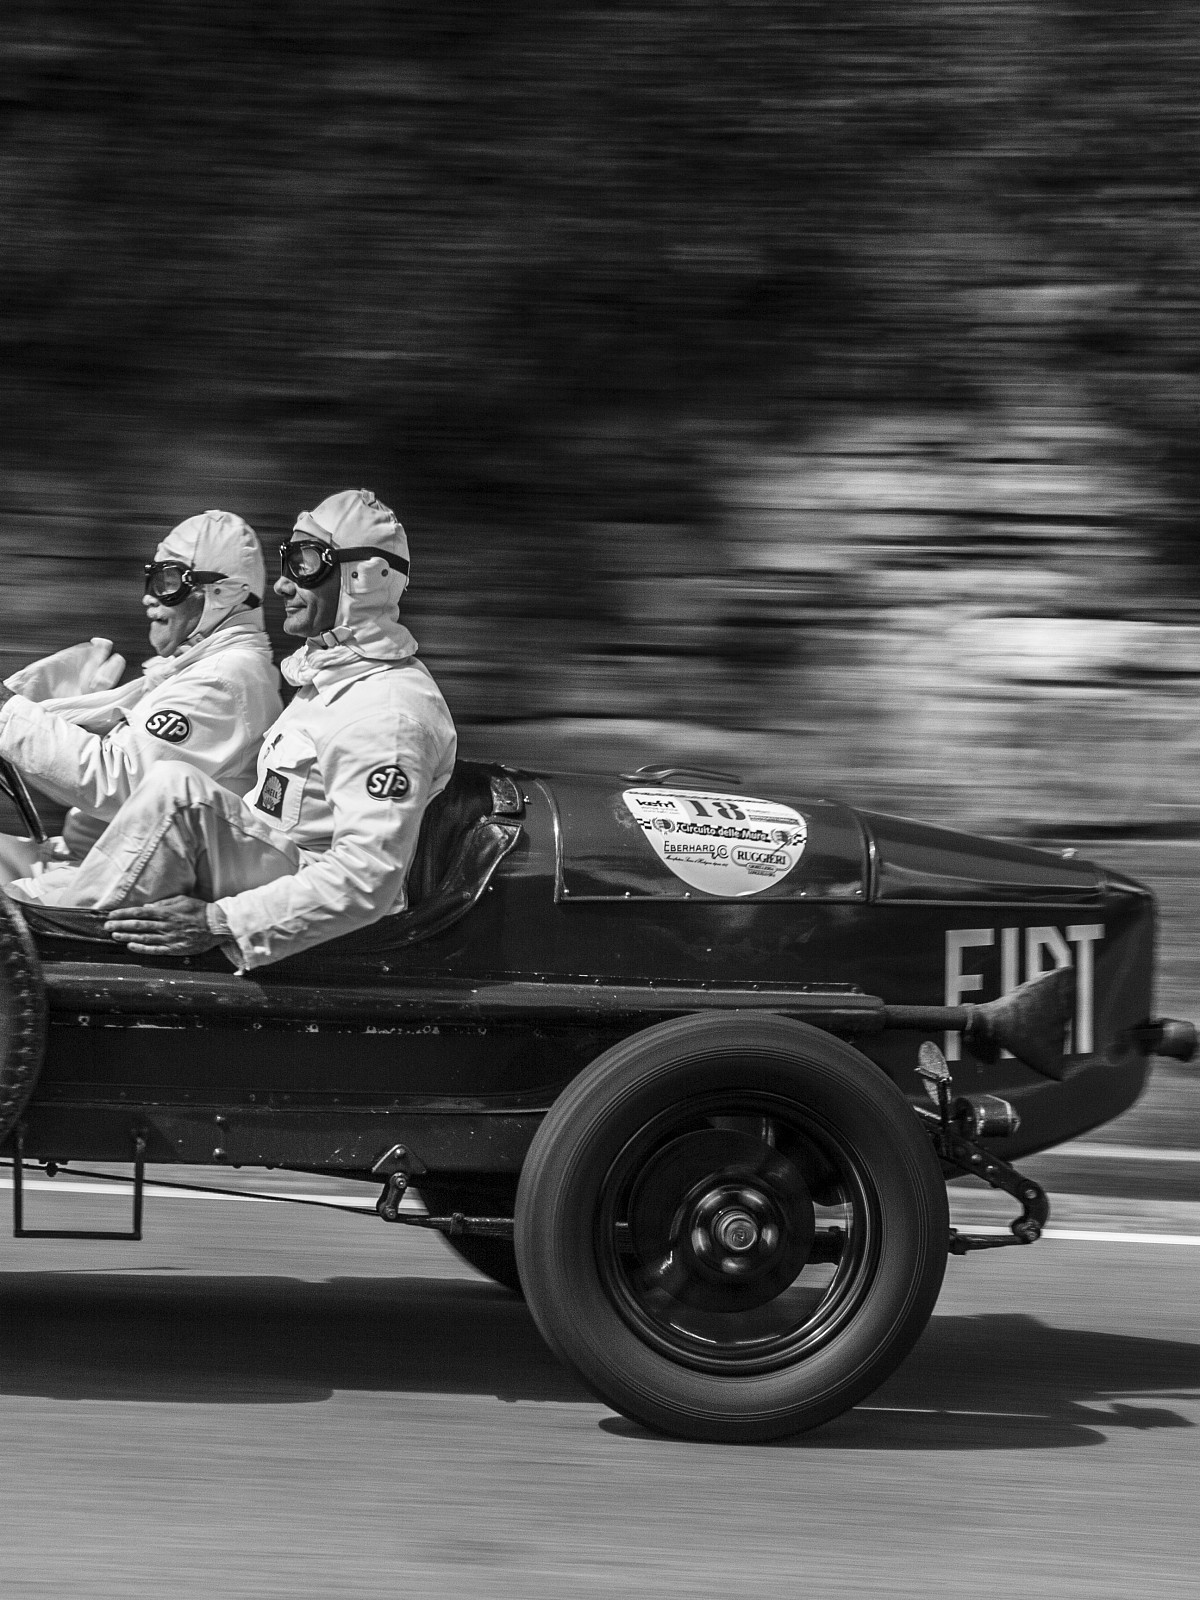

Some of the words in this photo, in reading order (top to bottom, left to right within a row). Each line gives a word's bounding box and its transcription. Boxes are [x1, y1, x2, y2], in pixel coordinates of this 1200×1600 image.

[147, 712, 188, 737] STP
[368, 767, 407, 797] STP
[264, 786, 278, 799] SHELL
[688, 800, 746, 821] 18
[680, 824, 716, 836] Circuito
[718, 827, 741, 838] delle
[742, 830, 768, 841] Mura
[664, 841, 716, 852] EBERHARD
[737, 851, 786, 865] RUGGIERI
